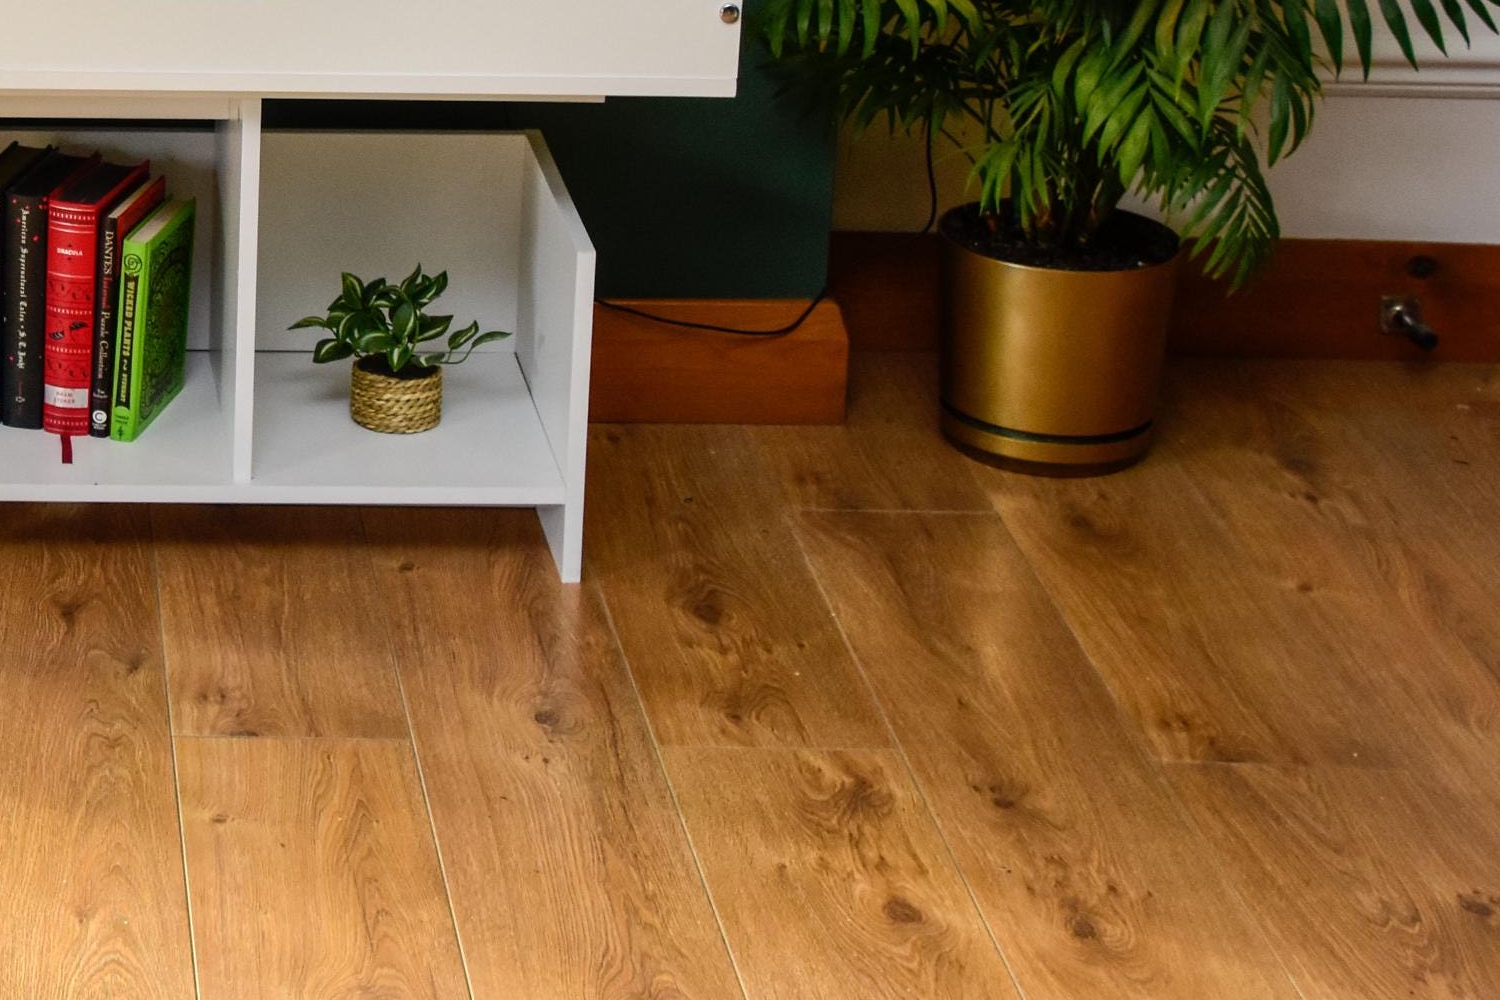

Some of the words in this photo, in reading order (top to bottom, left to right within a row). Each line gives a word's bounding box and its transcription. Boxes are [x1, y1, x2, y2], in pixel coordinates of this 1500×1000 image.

[20, 208, 30, 244] American
[56, 247, 84, 256] DRACULA
[19, 246, 29, 298] Supernatural
[18, 300, 28, 323] Tales
[125, 281, 136, 318] WICKED
[122, 319, 132, 357] PLANTS
